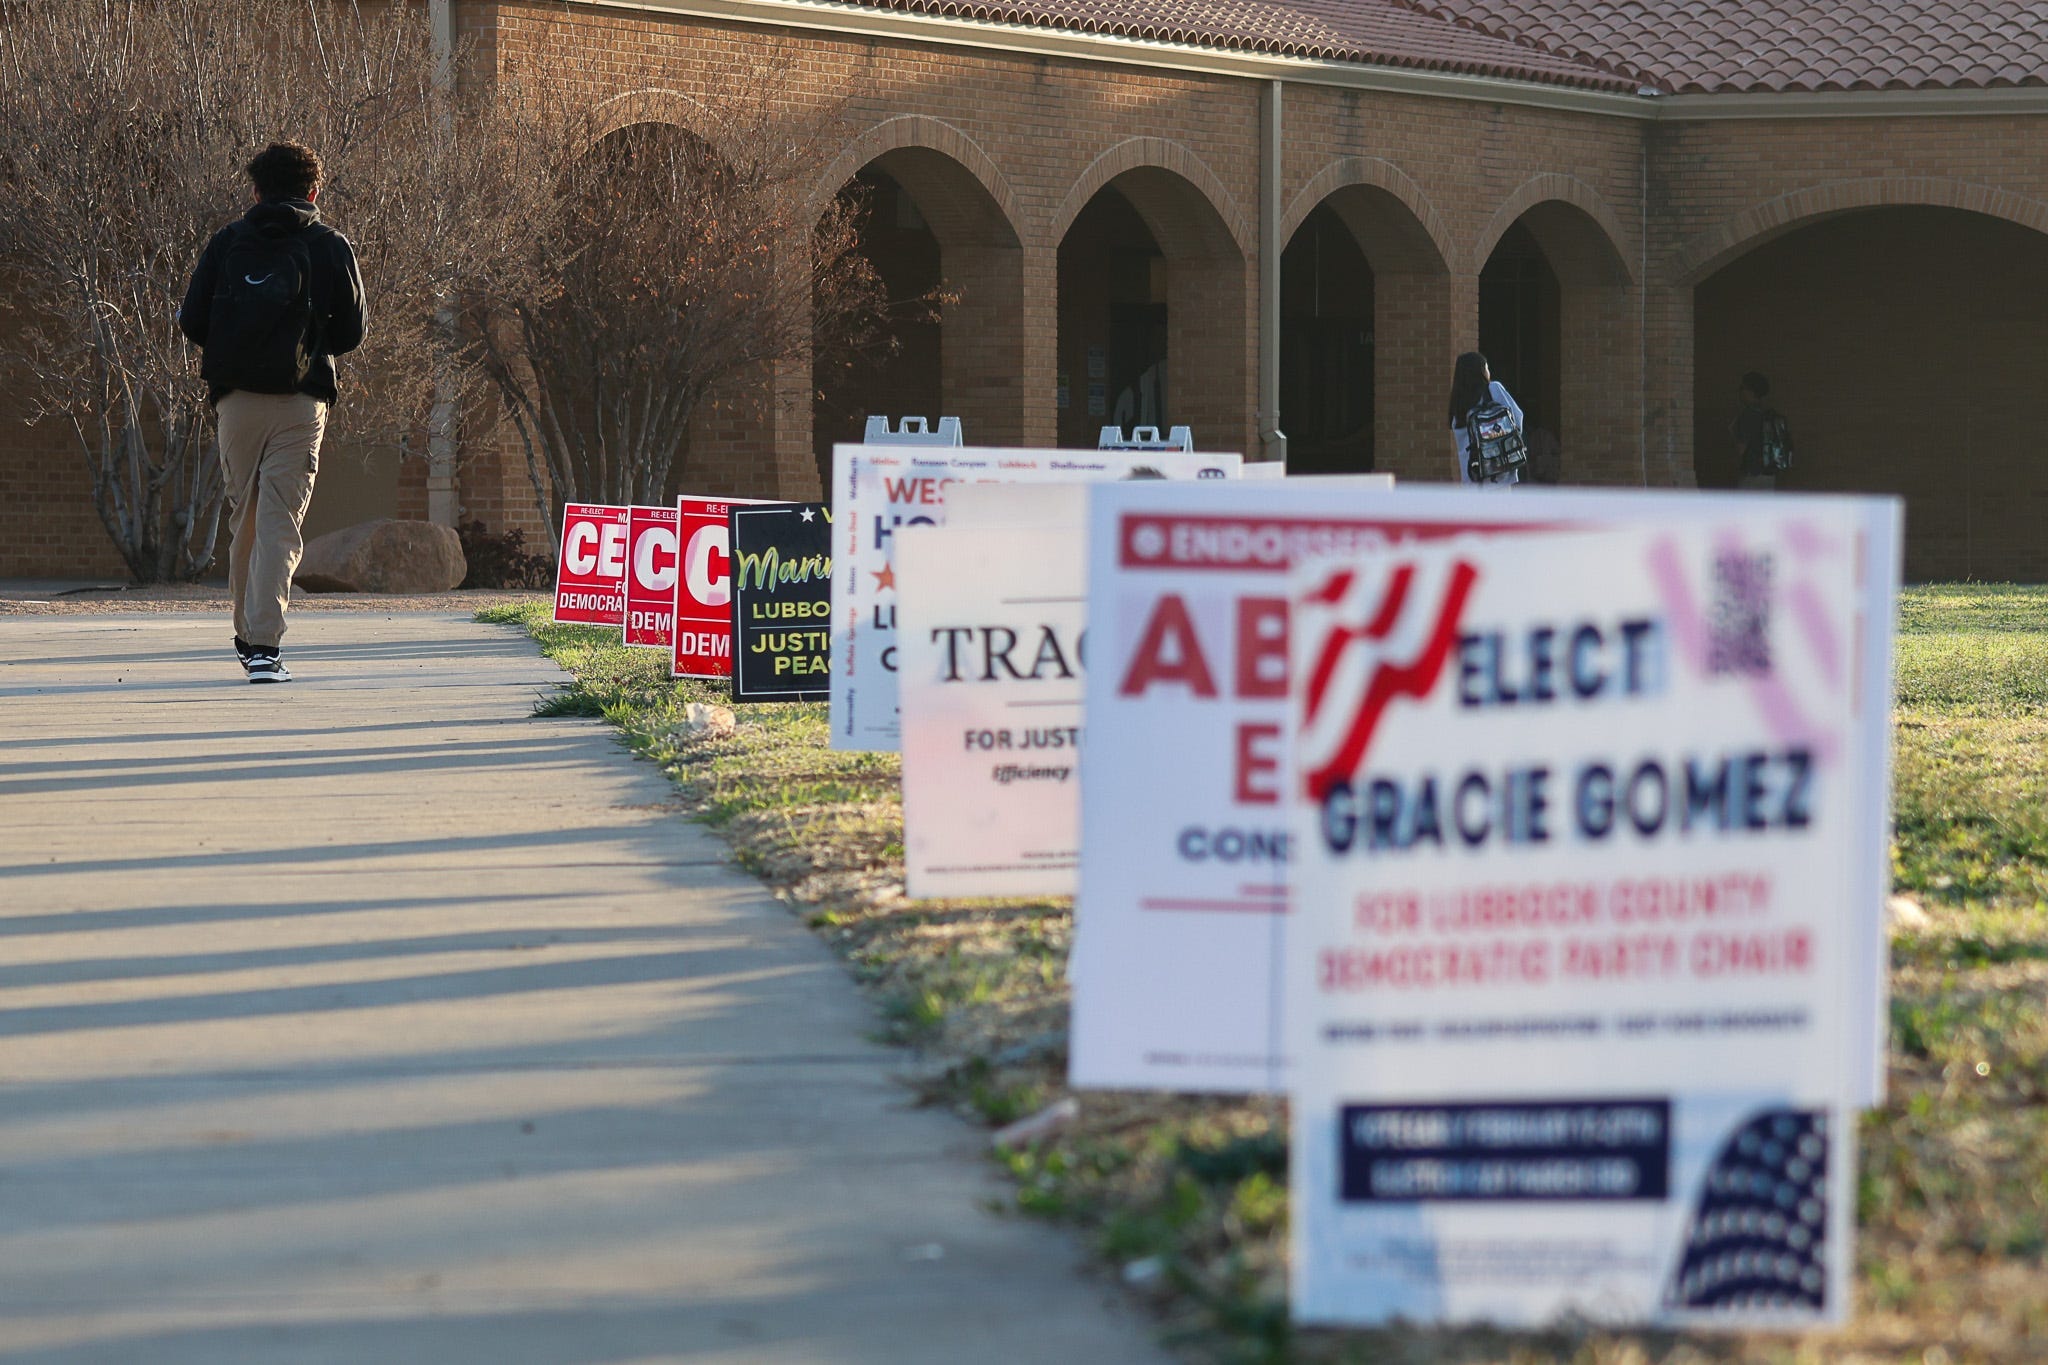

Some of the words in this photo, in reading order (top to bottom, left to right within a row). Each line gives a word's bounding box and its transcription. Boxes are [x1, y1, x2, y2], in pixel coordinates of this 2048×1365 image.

[580, 507, 605, 515] RE-ELECT
[565, 521, 627, 577] CE
[633, 527, 677, 591] C
[684, 525, 732, 607] C
[631, 611, 677, 631] DEM
[753, 600, 832, 619] LUBBO
[751, 632, 833, 653] JUSTI
[774, 655, 832, 676] PEA
[1457, 617, 1661, 708] ELECT
[964, 729, 1012, 750] FOR
[1235, 721, 1283, 804] E
[1322, 768, 1554, 858] GRACIE
[1574, 746, 1814, 842] GOMEZ
